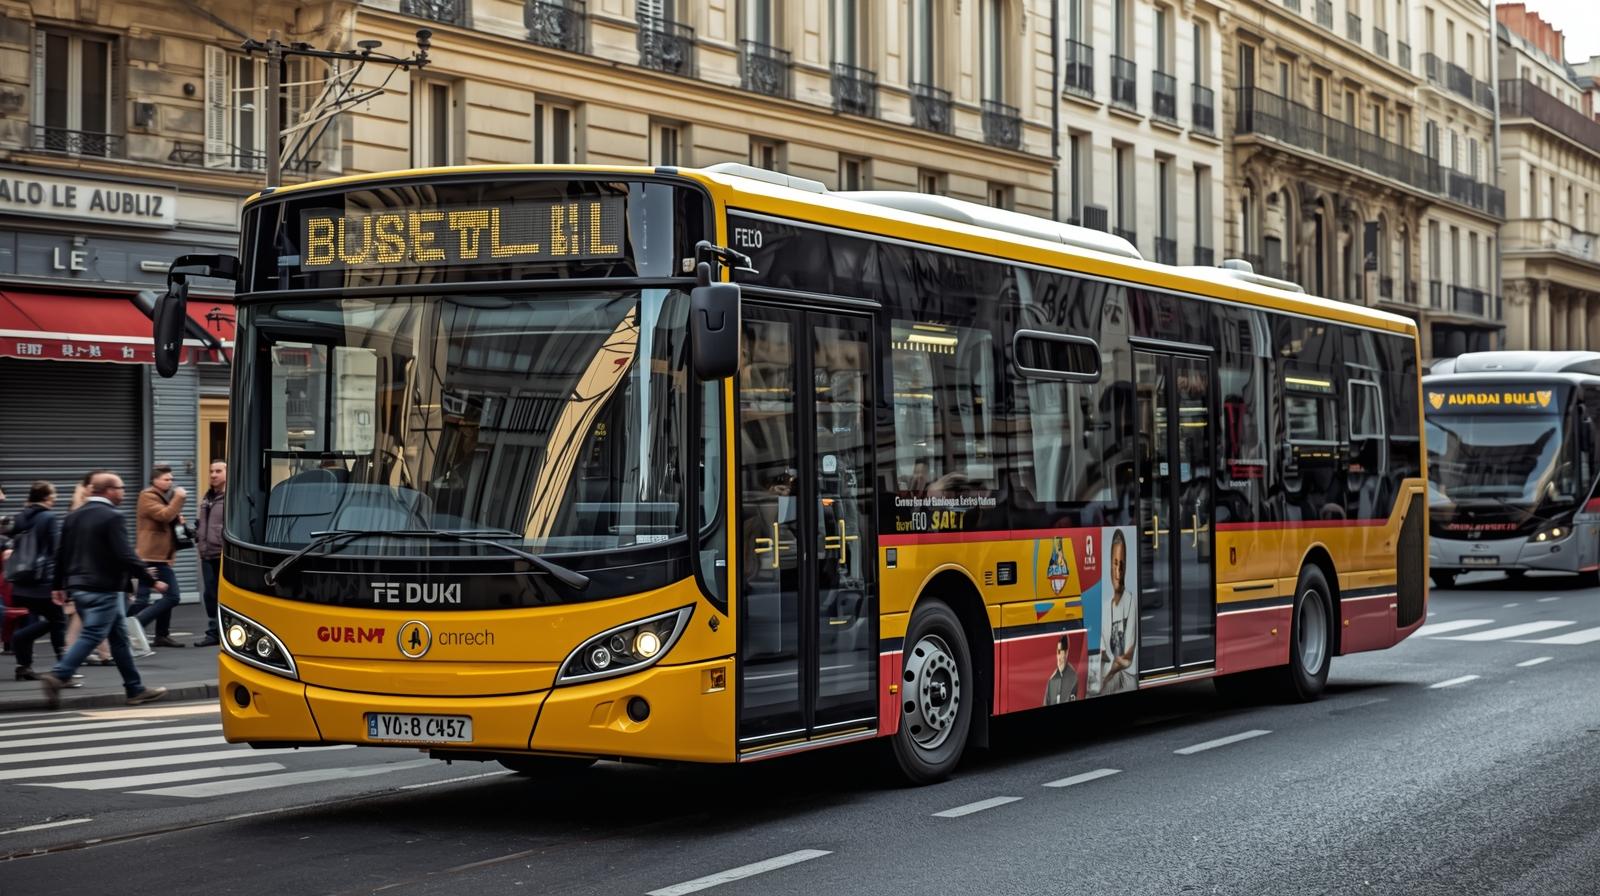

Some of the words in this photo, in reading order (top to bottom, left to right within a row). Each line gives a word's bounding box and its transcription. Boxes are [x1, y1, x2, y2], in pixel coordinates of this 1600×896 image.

[52, 185, 77, 209] LE
[90, 189, 164, 217] AUBLIZ
[406, 583, 461, 603] DUKI
